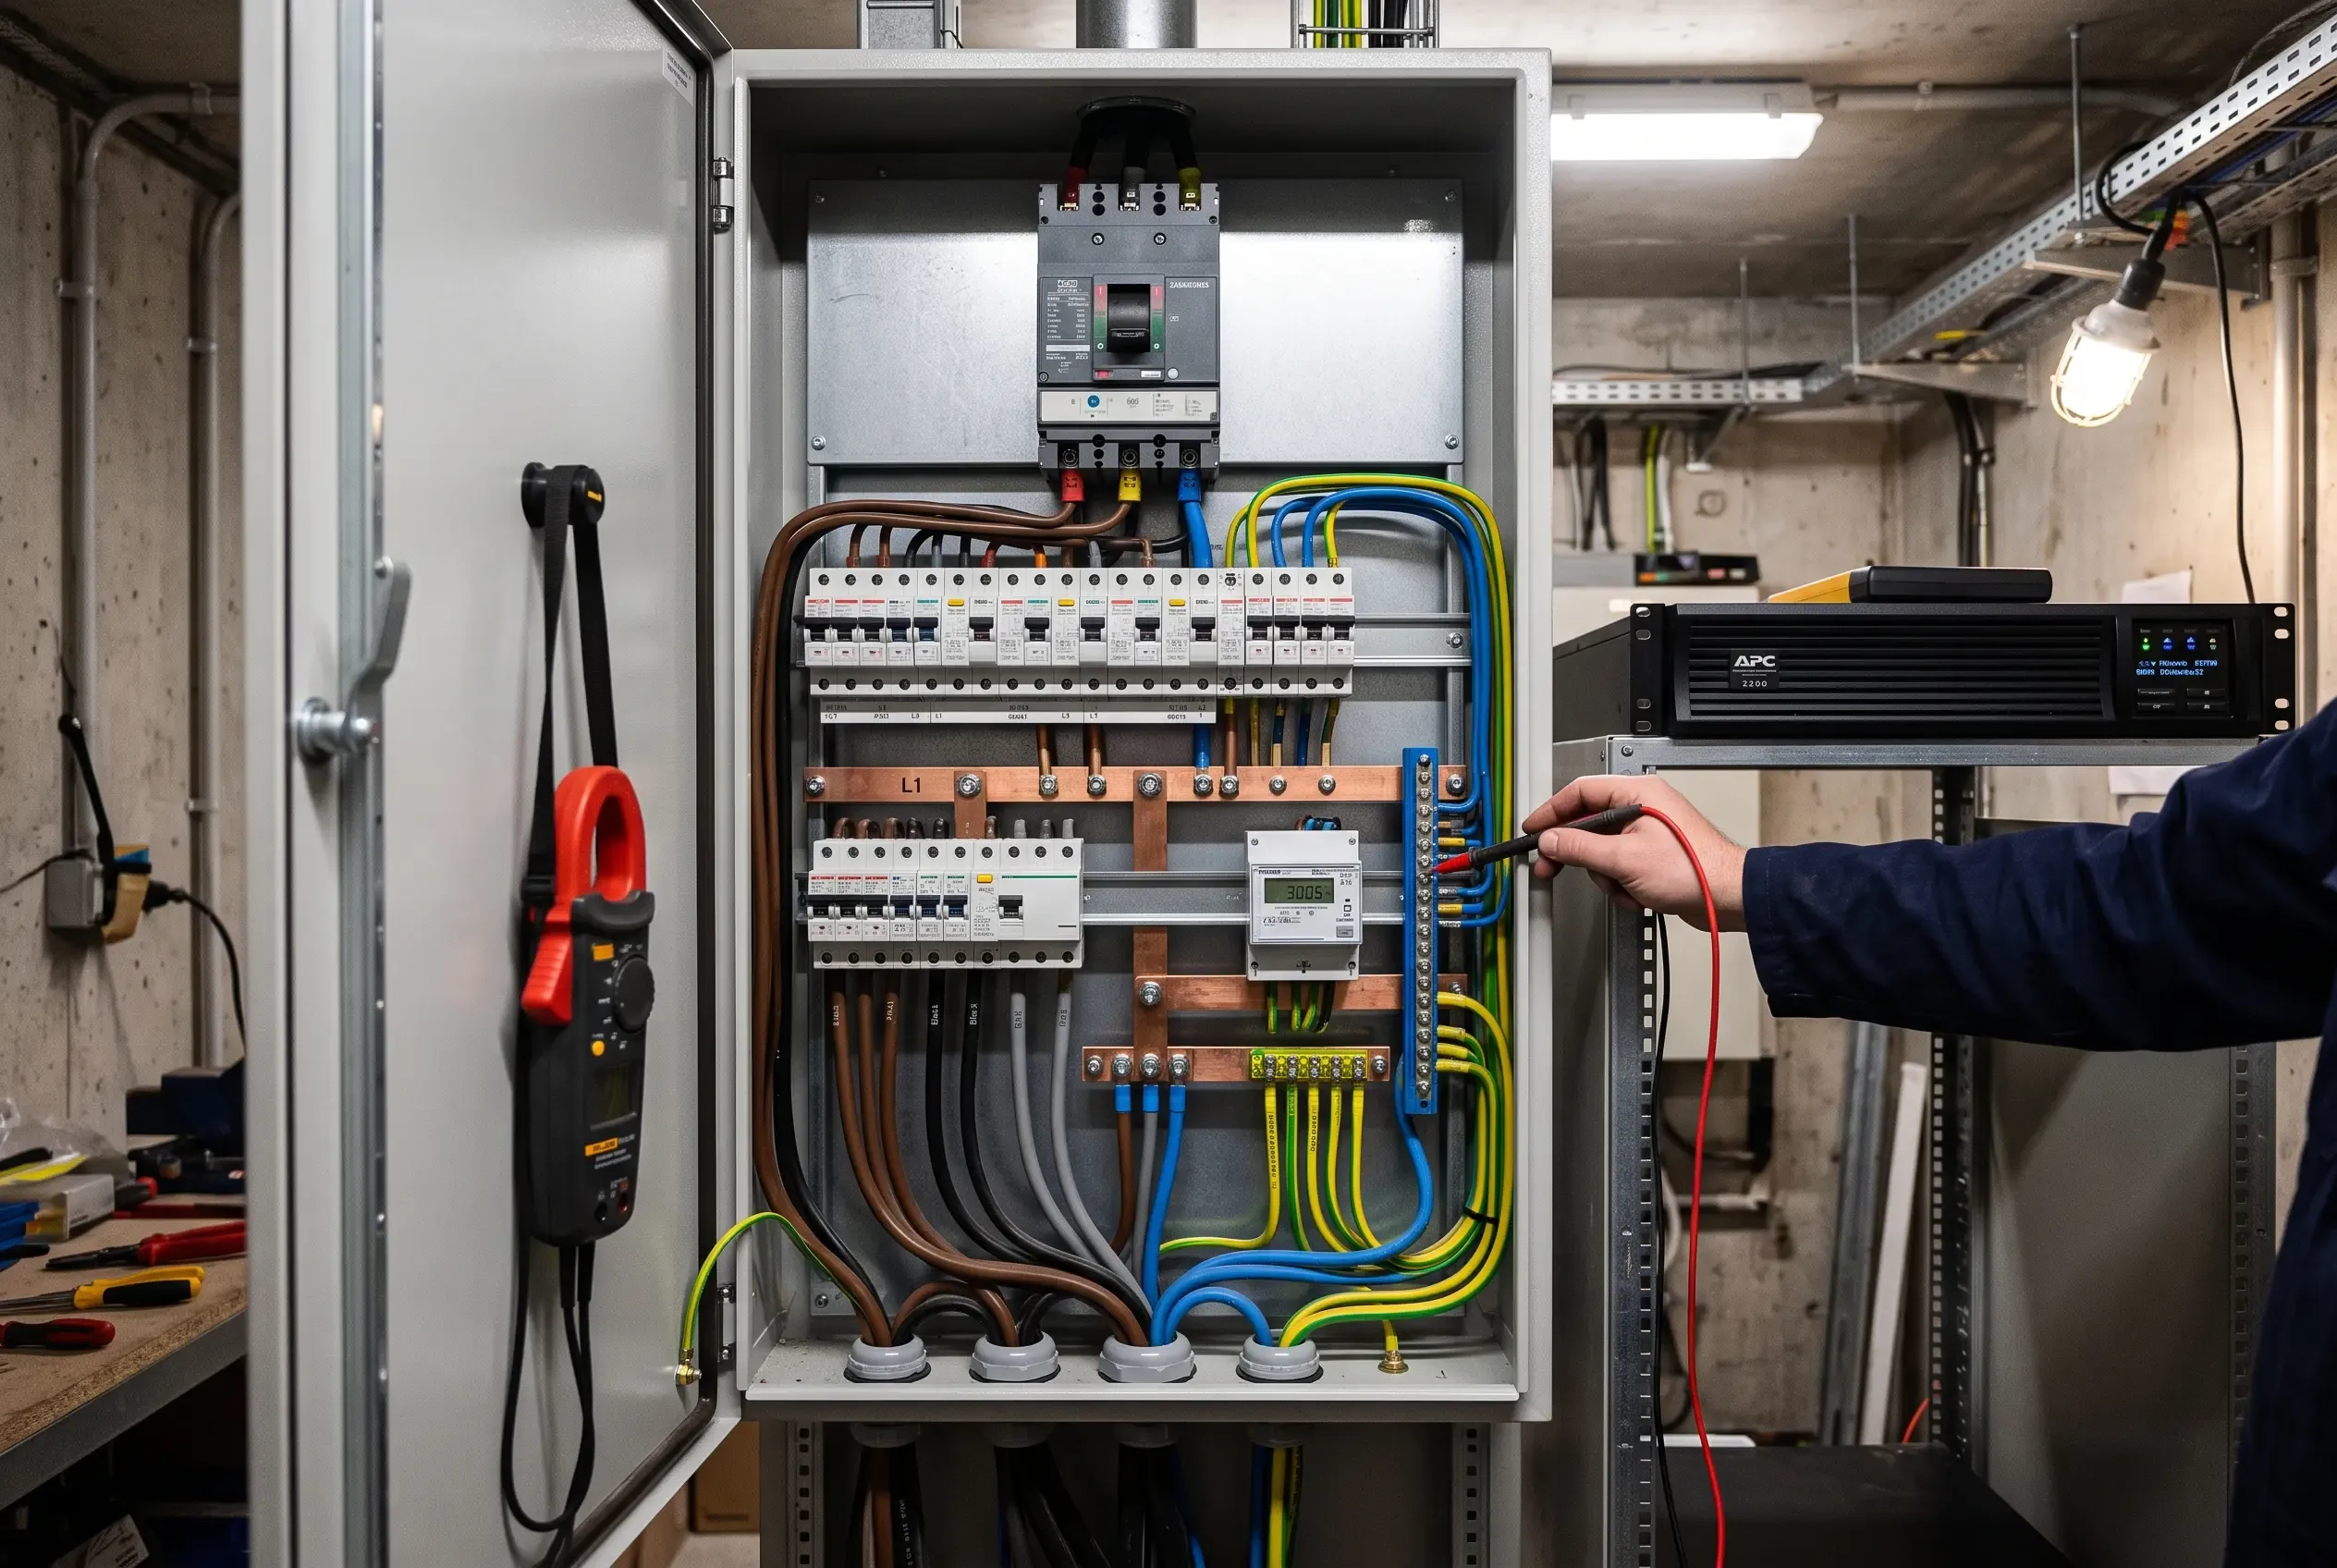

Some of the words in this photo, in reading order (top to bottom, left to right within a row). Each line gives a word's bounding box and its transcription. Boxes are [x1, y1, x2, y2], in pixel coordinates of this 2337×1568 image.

[1734, 655, 1776, 668] APC
[1743, 680, 1768, 688] 2200
[901, 778, 922, 793] L1
[1287, 885, 1323, 900] 3005
